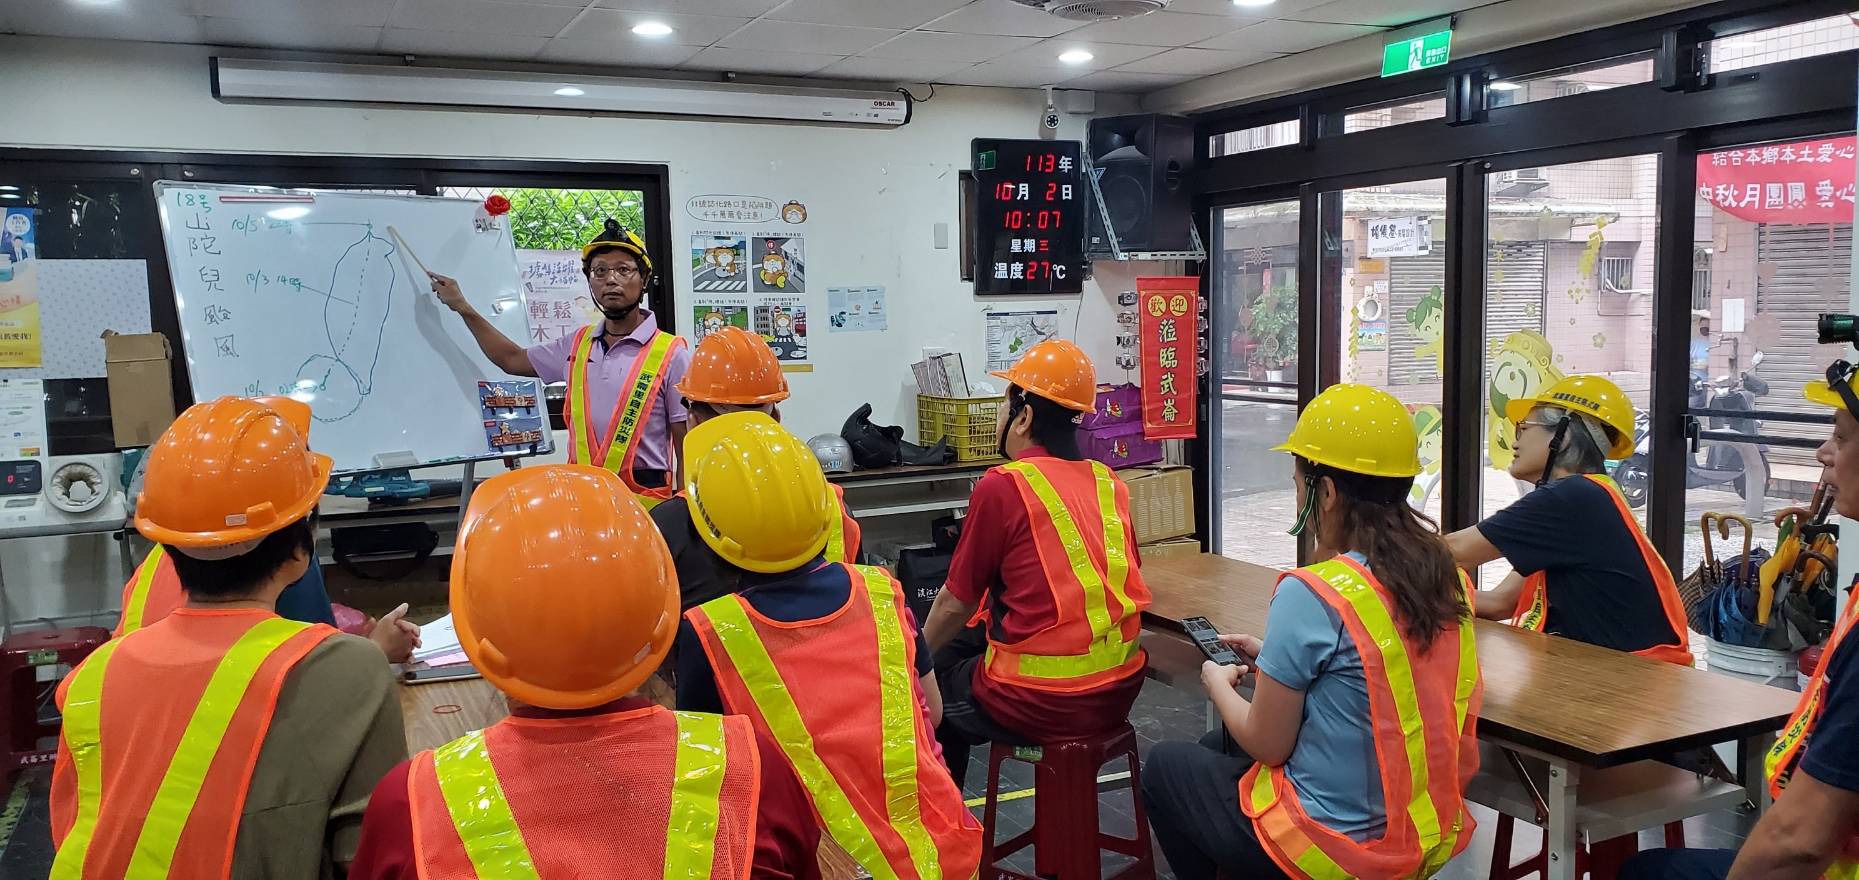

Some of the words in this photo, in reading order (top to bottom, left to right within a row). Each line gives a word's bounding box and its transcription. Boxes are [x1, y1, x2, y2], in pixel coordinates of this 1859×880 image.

[1425, 54, 1445, 64] EXIT
[1004, 211, 1061, 229] 10:07
[1010, 239, 1049, 253] 星期三
[530, 301, 572, 319] 輕鬆
[1150, 297, 1186, 315] 歡迎
[1158, 319, 1179, 423] 蒞臨武崙
